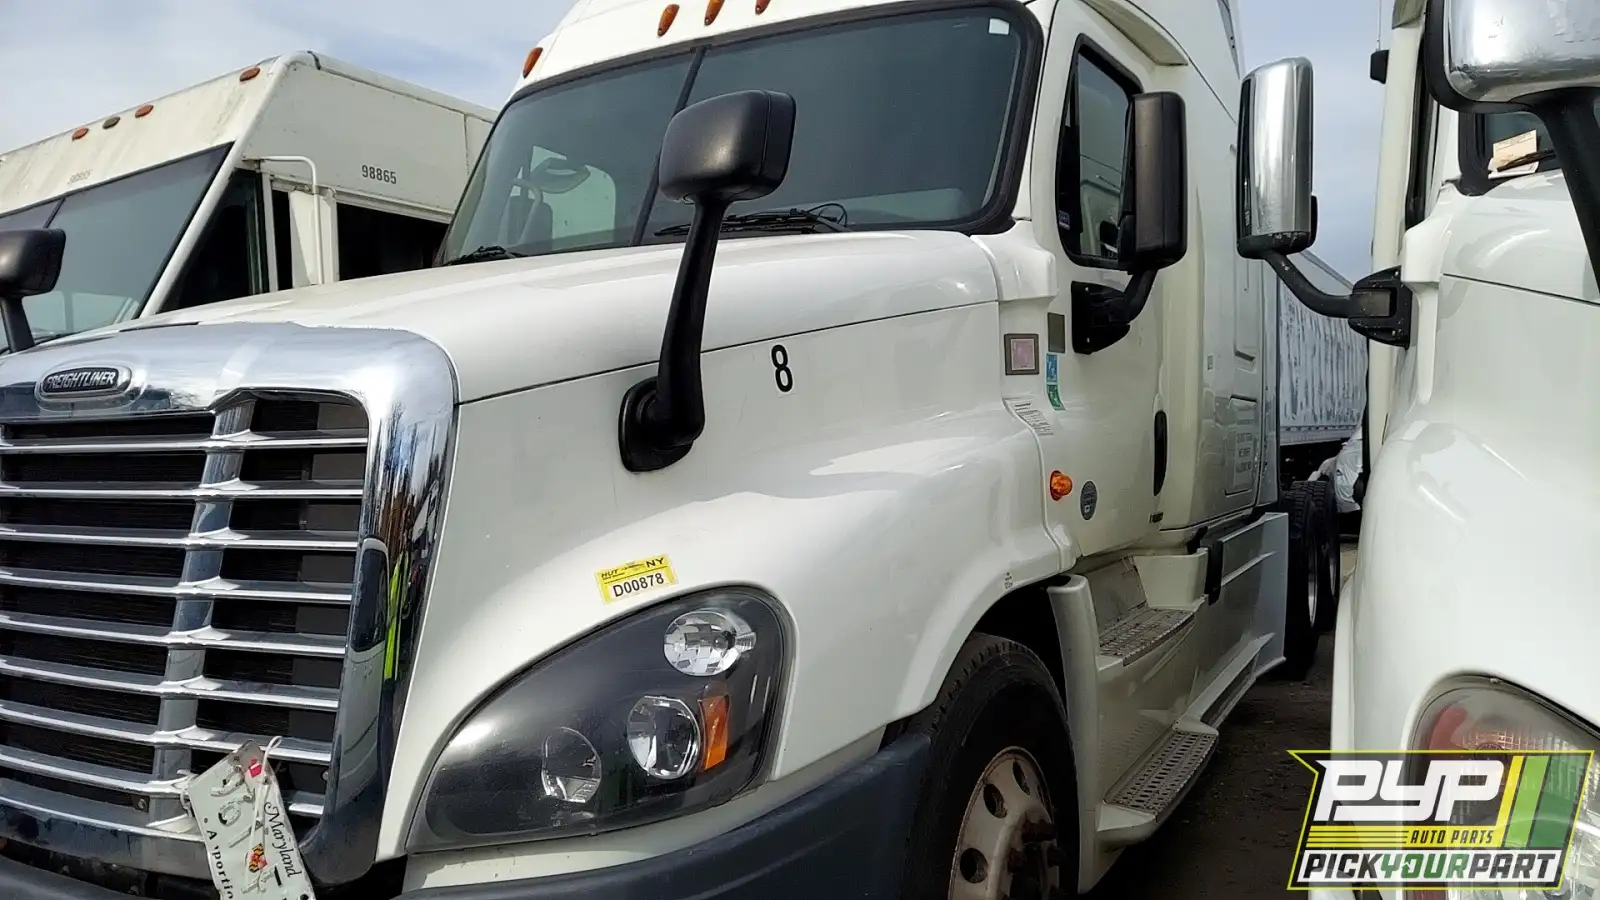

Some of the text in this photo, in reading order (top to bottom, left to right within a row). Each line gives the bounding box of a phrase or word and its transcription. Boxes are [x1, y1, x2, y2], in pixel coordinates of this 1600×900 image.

[361, 164, 397, 185] 98865
[45, 371, 116, 389] FREIGHTLINER
[771, 344, 793, 393] 8
[646, 557, 664, 568] NY
[612, 572, 664, 597] D00878
[264, 802, 302, 877] Maryland
